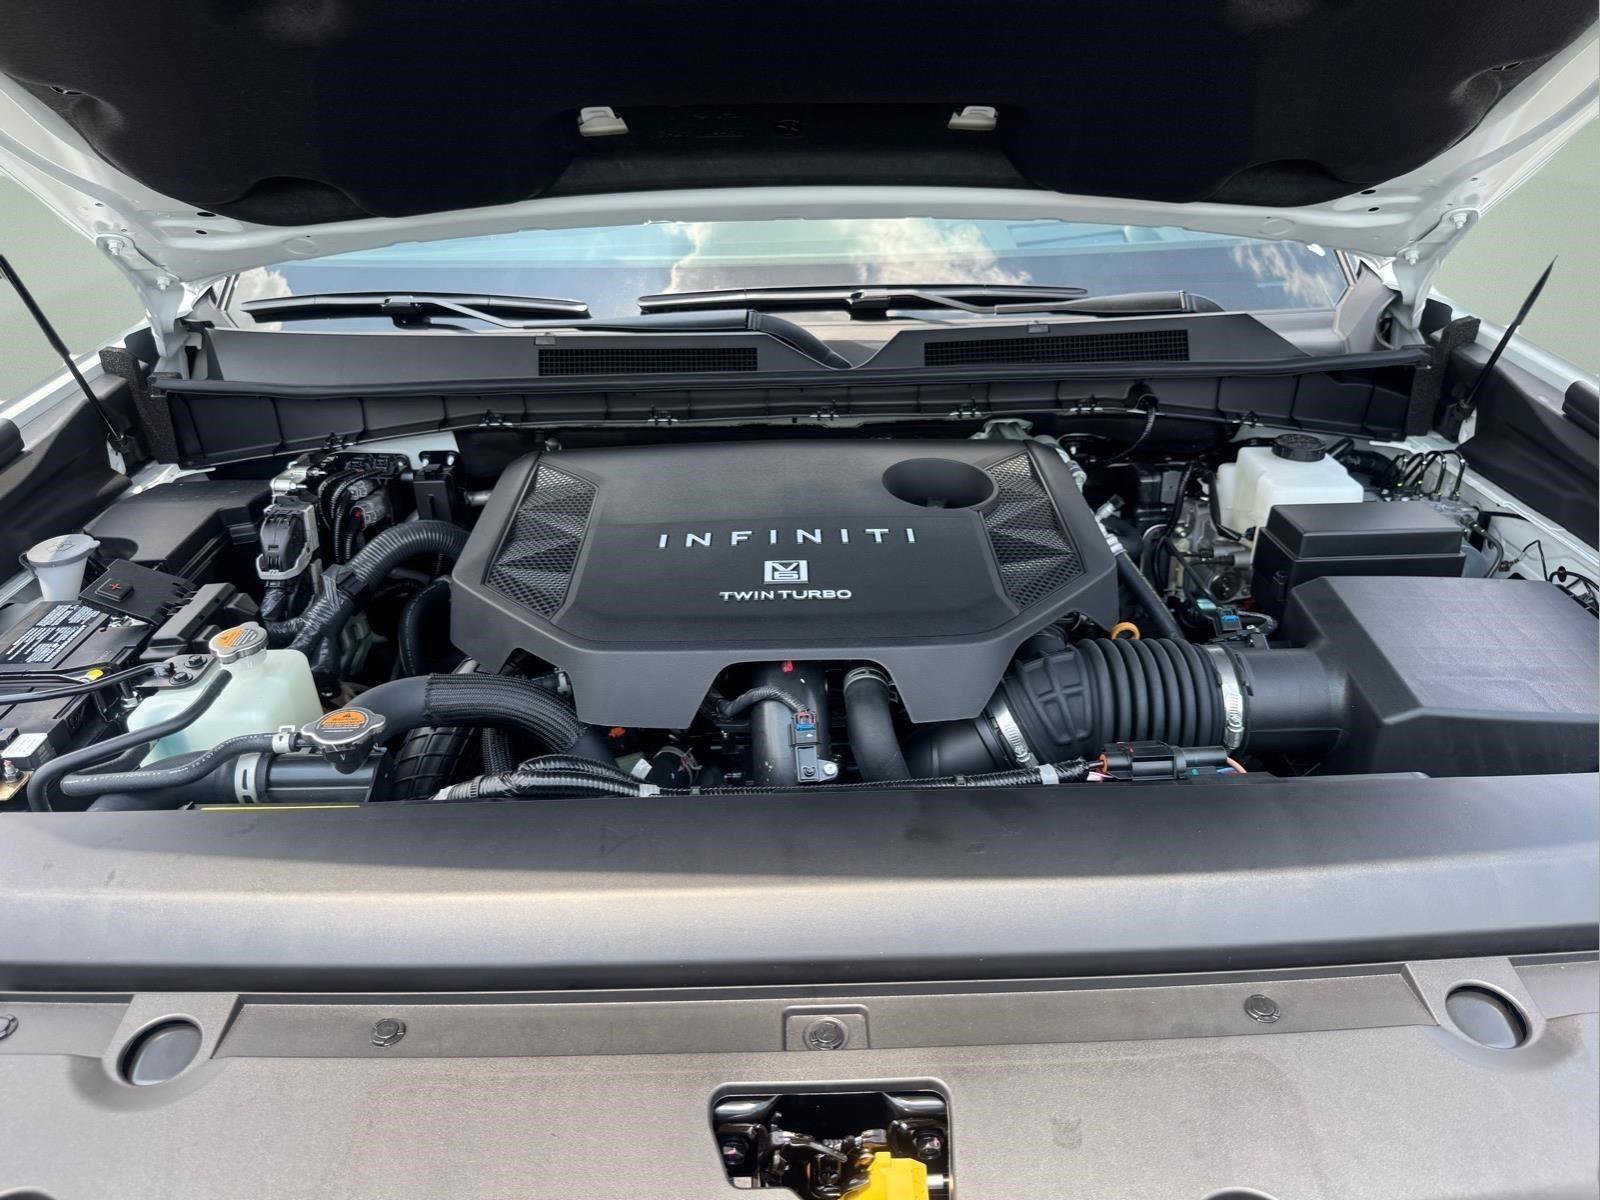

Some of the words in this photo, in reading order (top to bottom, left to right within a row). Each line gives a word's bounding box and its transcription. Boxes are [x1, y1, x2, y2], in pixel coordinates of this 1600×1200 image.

[658, 528, 917, 549] INFINITI
[719, 590, 775, 602] TWIN
[778, 589, 853, 600] TURBO
